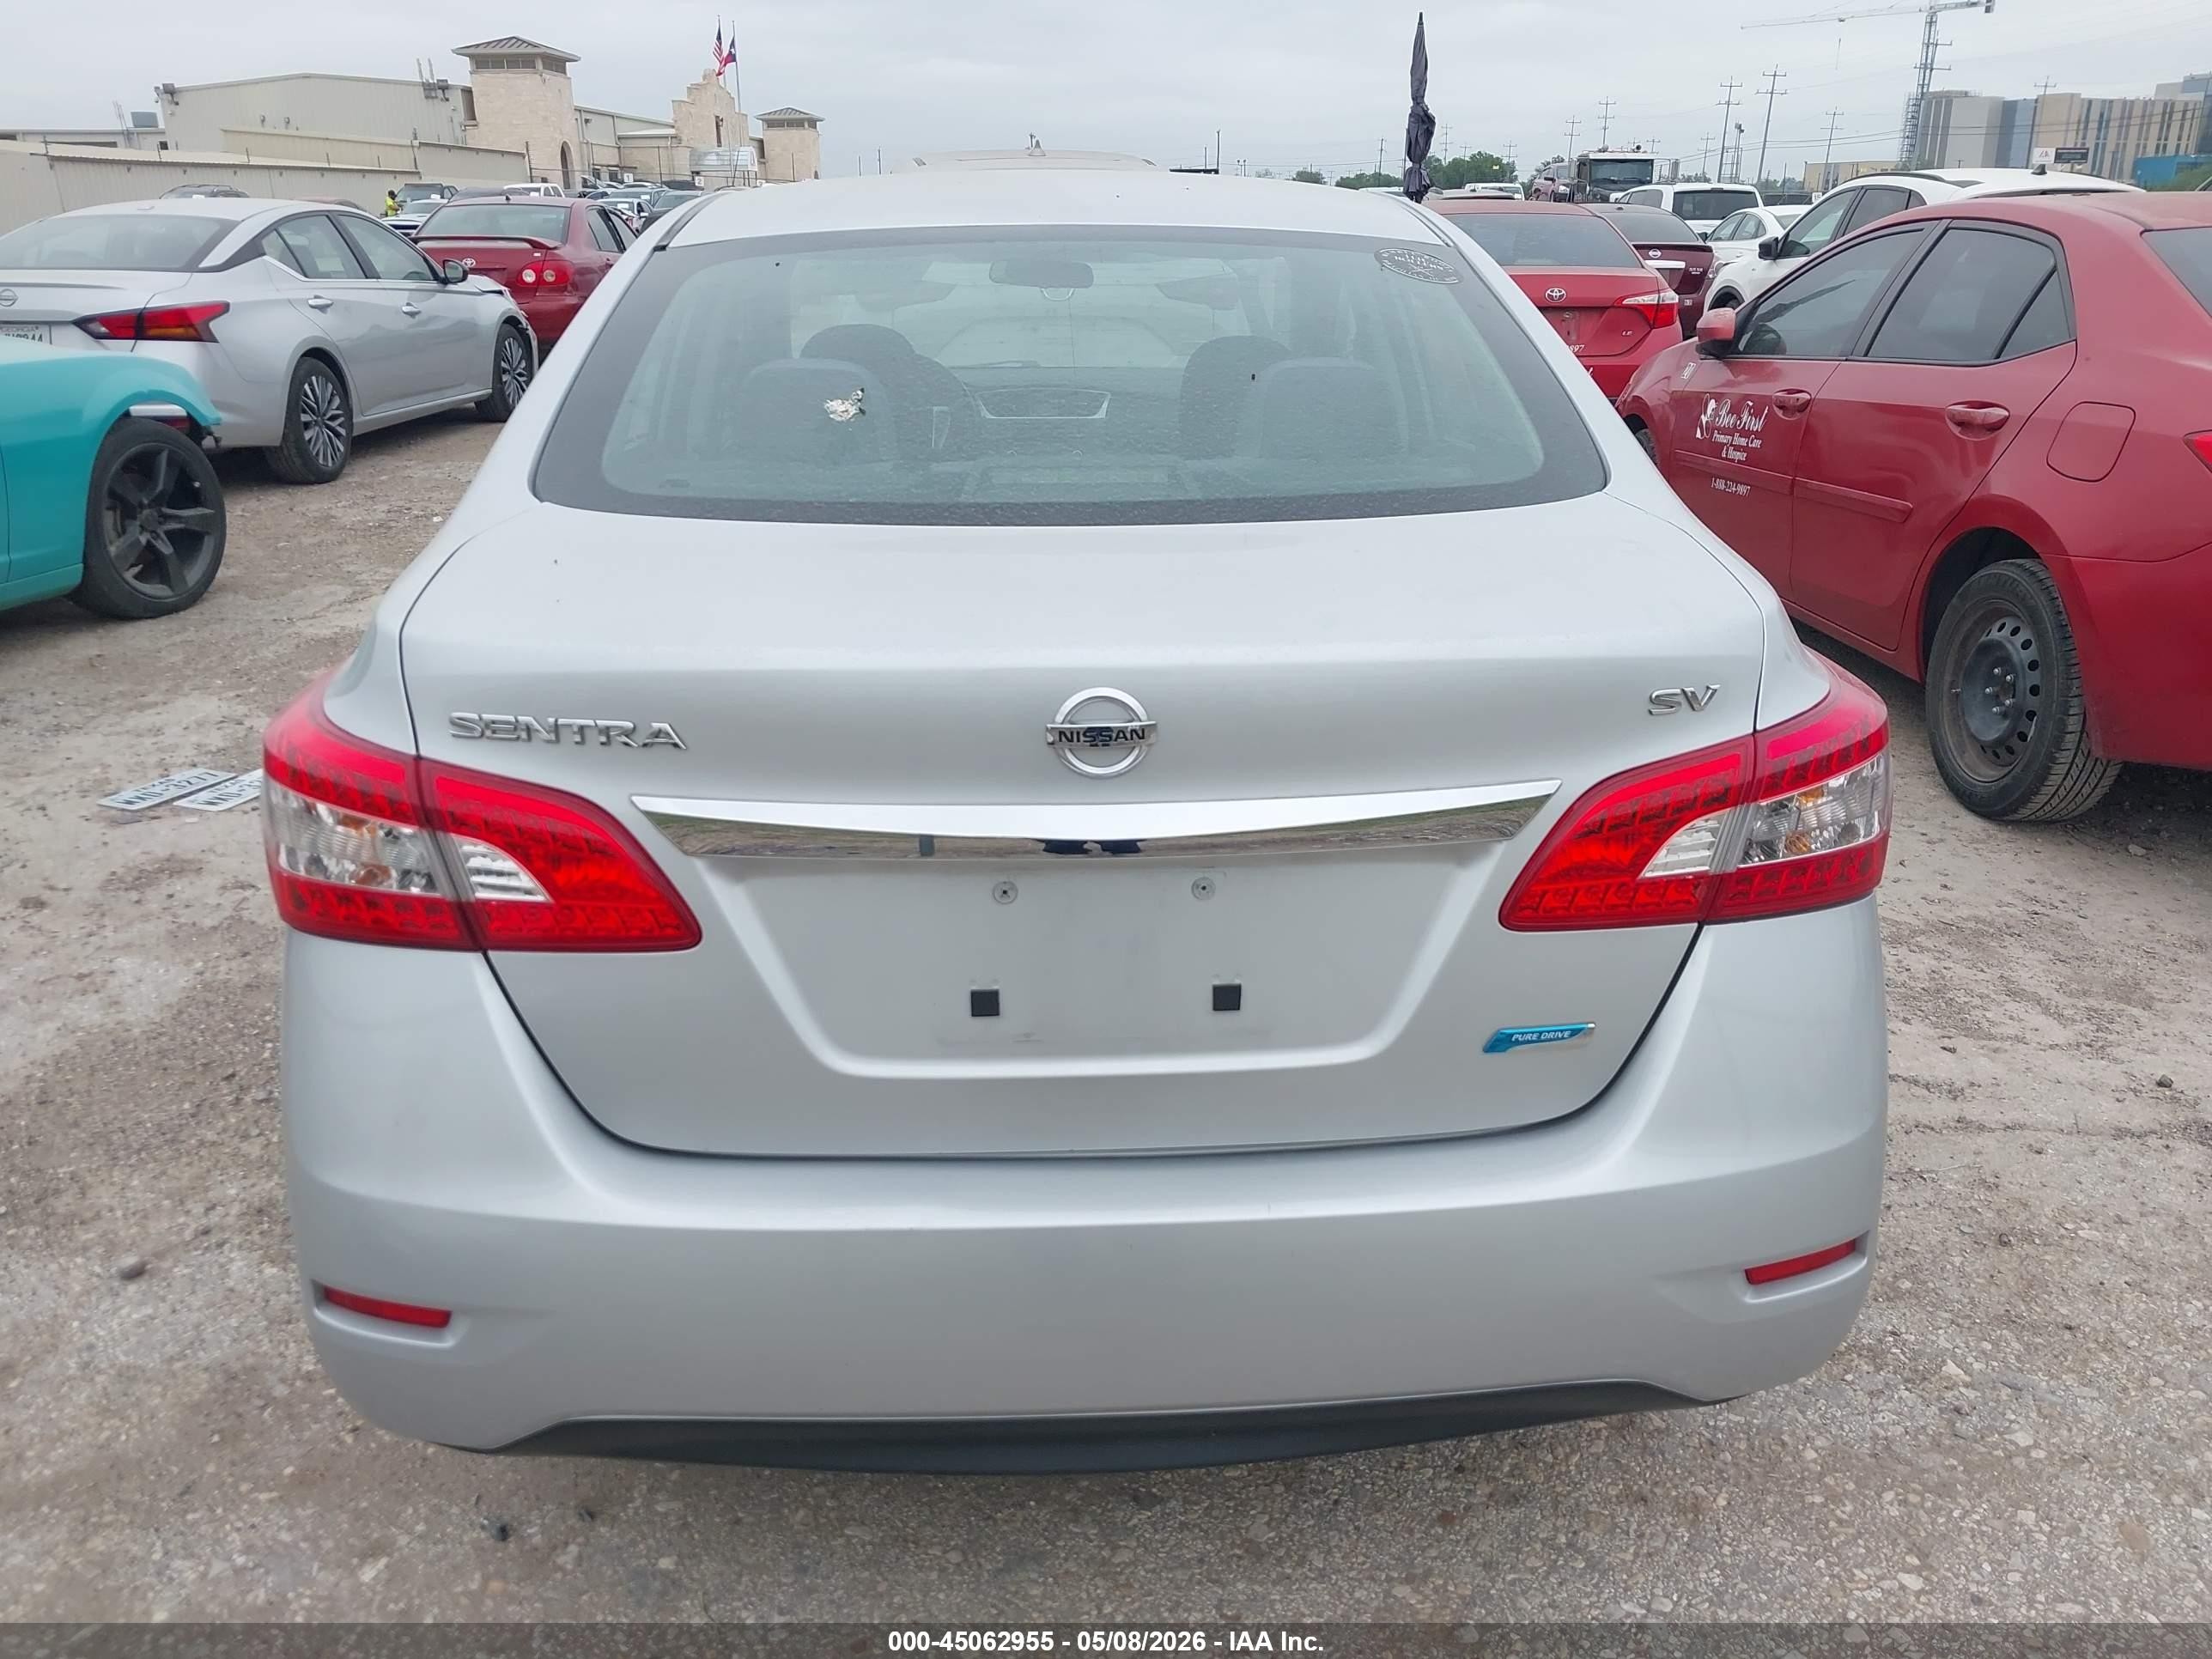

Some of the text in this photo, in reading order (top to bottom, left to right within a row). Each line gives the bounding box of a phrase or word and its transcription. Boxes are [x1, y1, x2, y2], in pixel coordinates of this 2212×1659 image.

[1716, 398, 1769, 432] Bee First
[1711, 429, 1762, 448] Primary Home Care
[1727, 446, 1747, 463] Hospice
[1711, 477, 1751, 497] 1-888-224-9897
[1648, 684, 1721, 715] SV
[448, 712, 687, 750] SENTRA
[1058, 727, 1146, 744] NISSAN
[1511, 1030, 1573, 1042] PURE DRIVE
